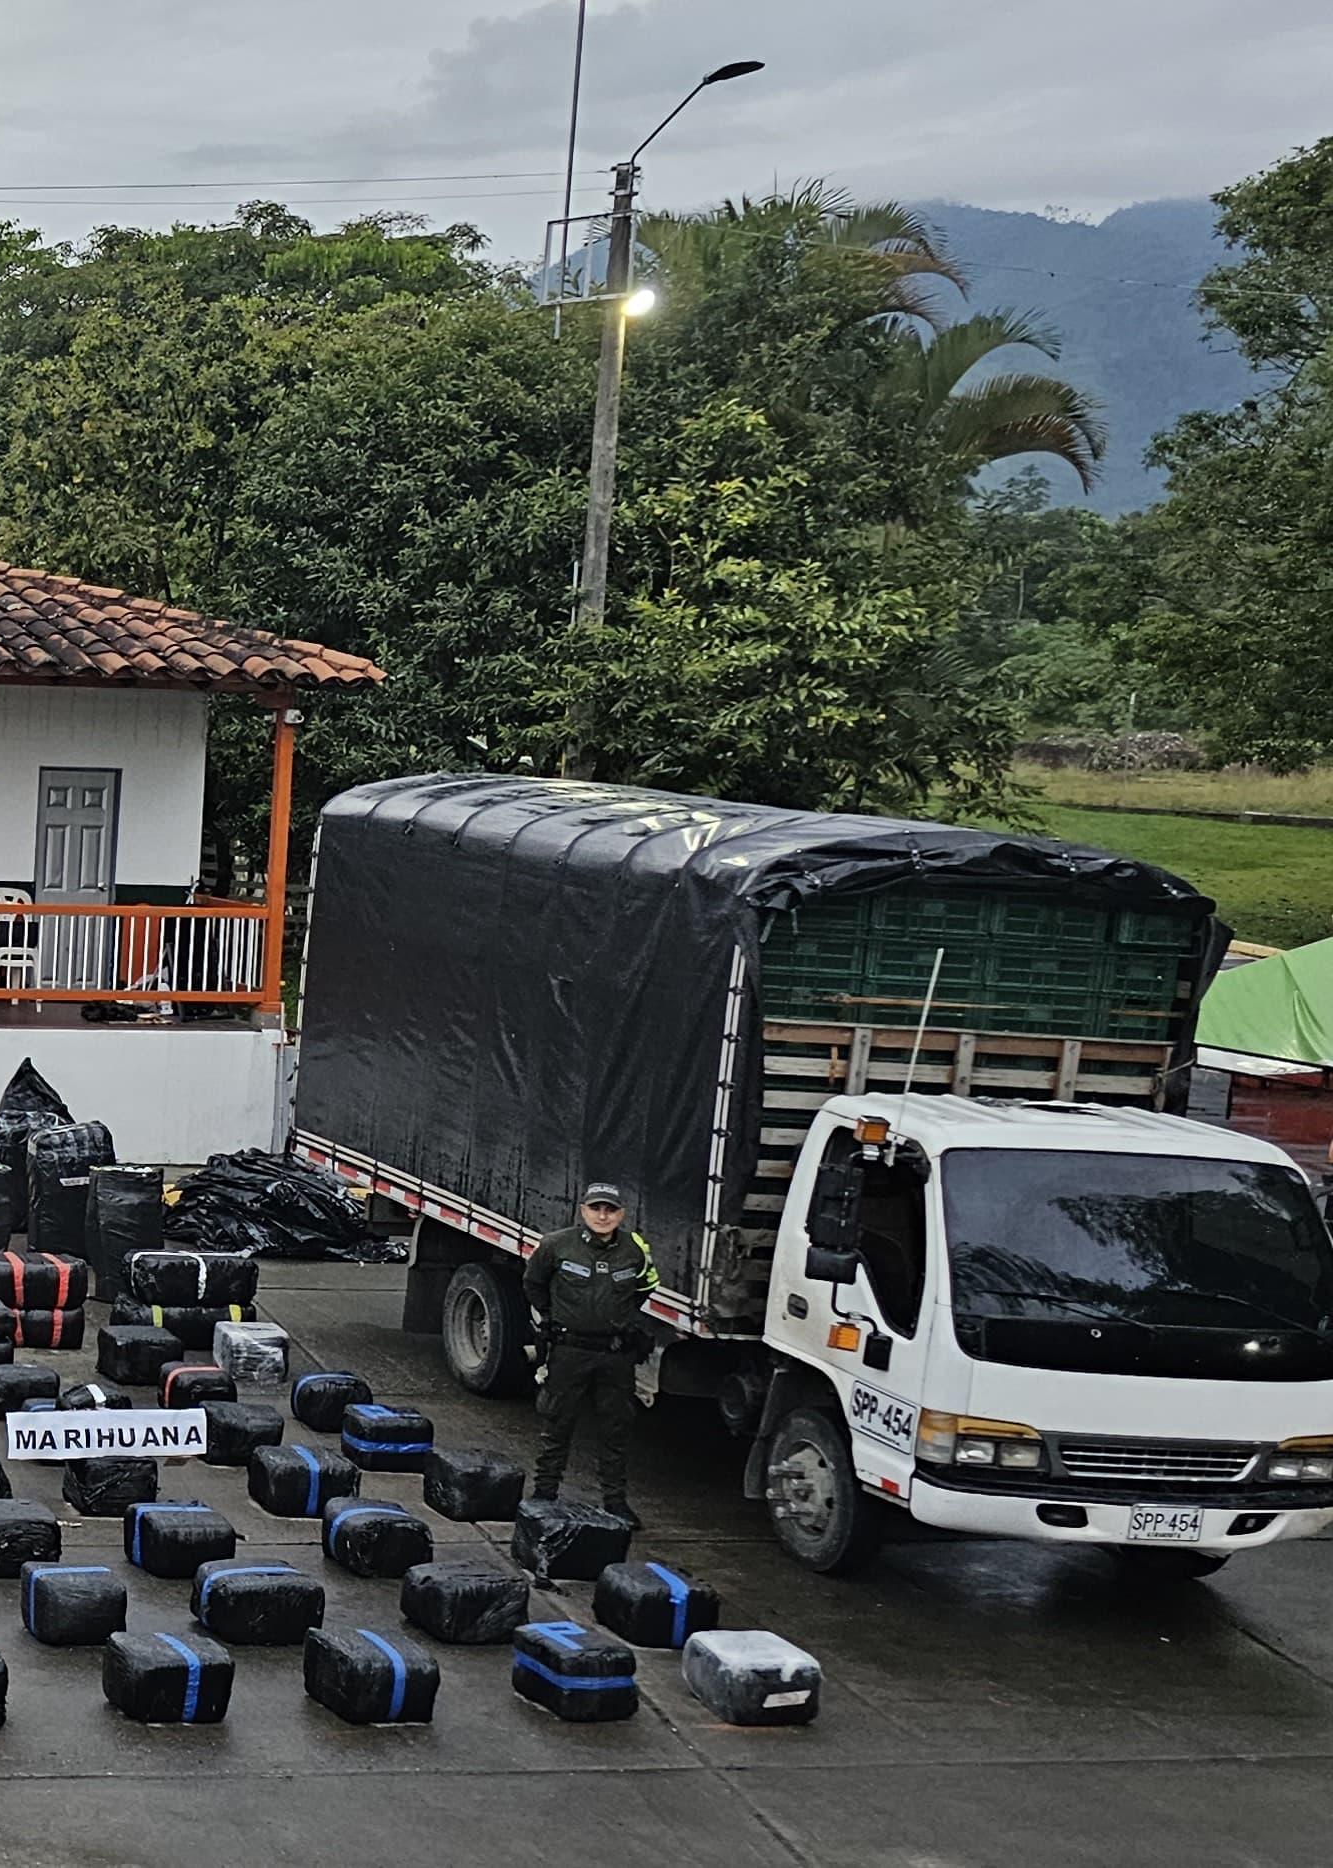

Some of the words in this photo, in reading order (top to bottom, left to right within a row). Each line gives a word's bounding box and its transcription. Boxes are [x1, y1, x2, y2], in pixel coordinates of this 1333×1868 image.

[852, 1388, 913, 1441] SPP-454
[15, 1425, 203, 1450] MARIHUANA
[1132, 1513, 1200, 1532] SPP-454
